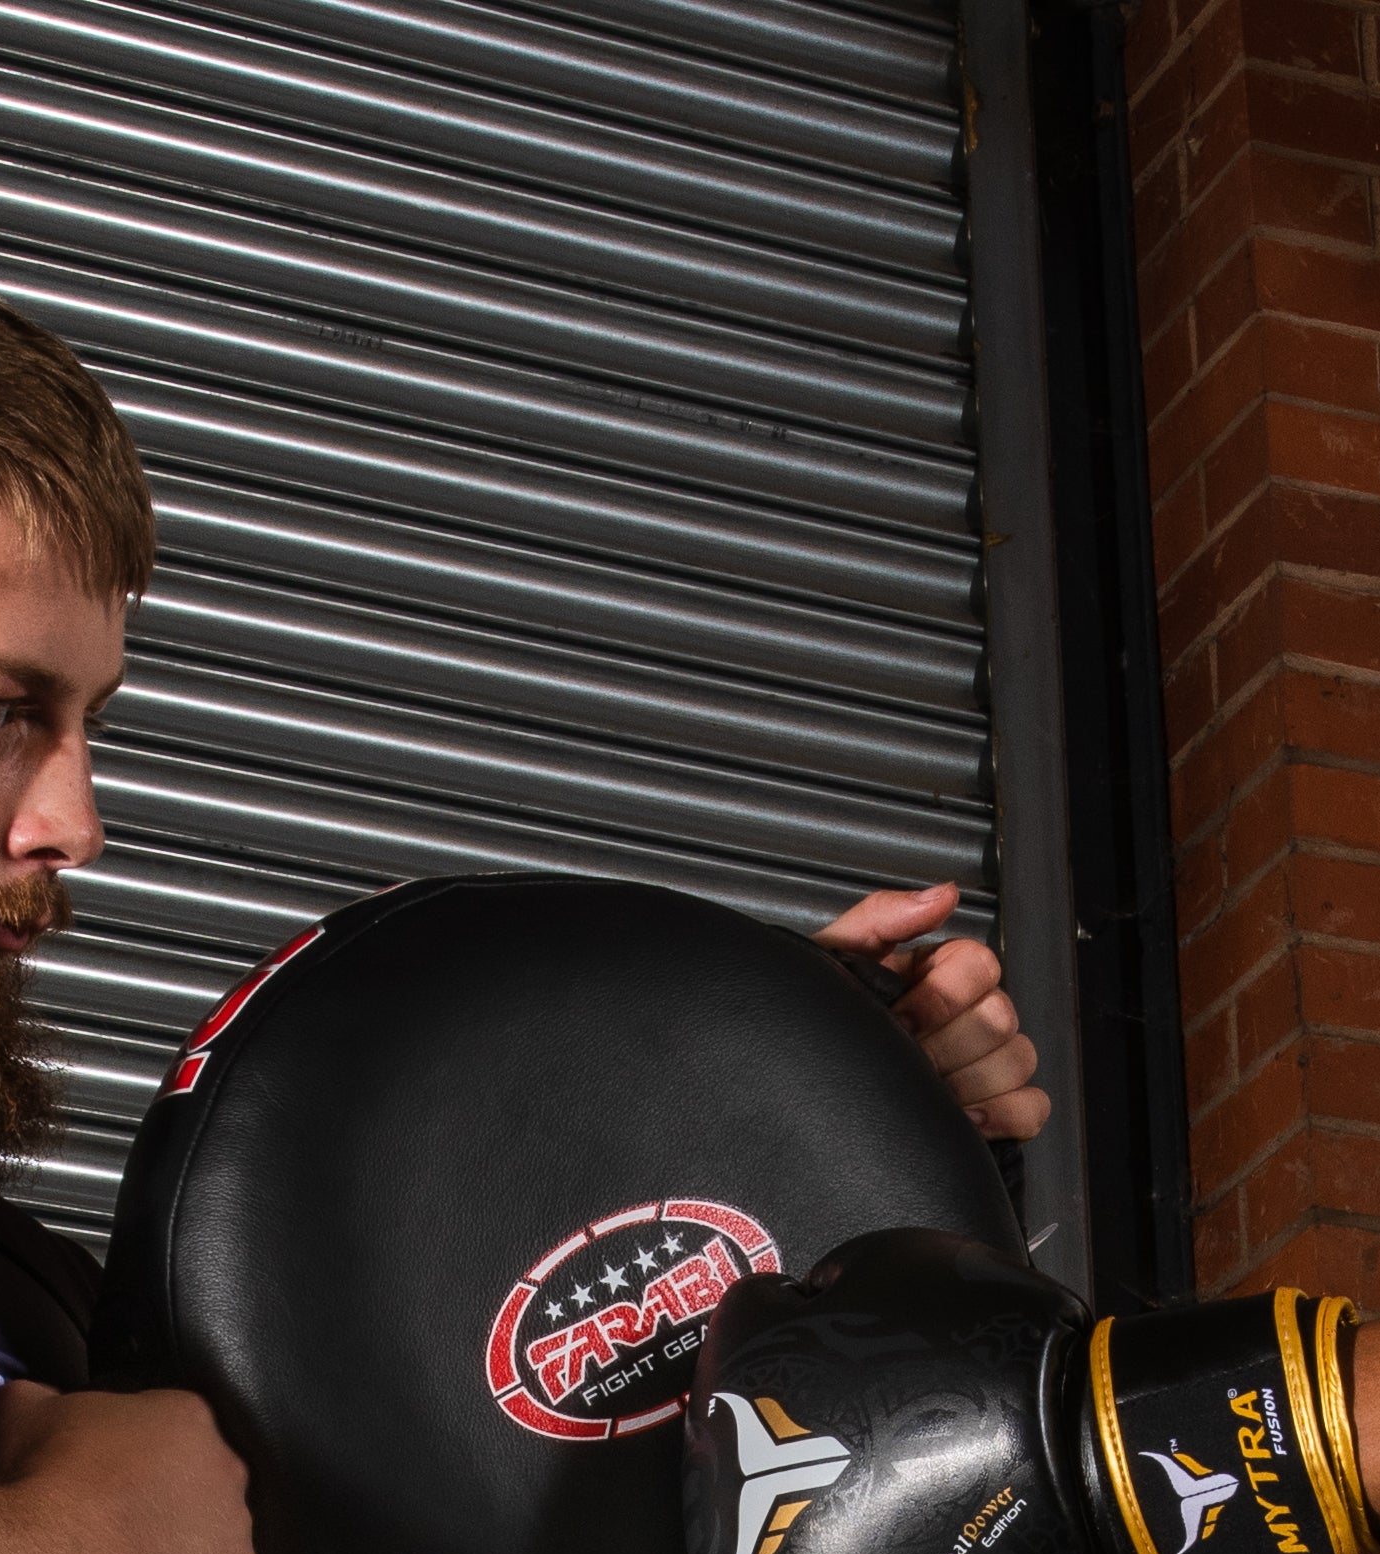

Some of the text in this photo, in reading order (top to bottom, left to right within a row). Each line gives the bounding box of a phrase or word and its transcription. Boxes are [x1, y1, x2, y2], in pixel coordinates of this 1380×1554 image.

[527, 1237, 740, 1405] FARABI
[582, 1354, 661, 1406] FIGHT
[1262, 1388, 1287, 1455] FUSION
[981, 1499, 1027, 1548] Edition
